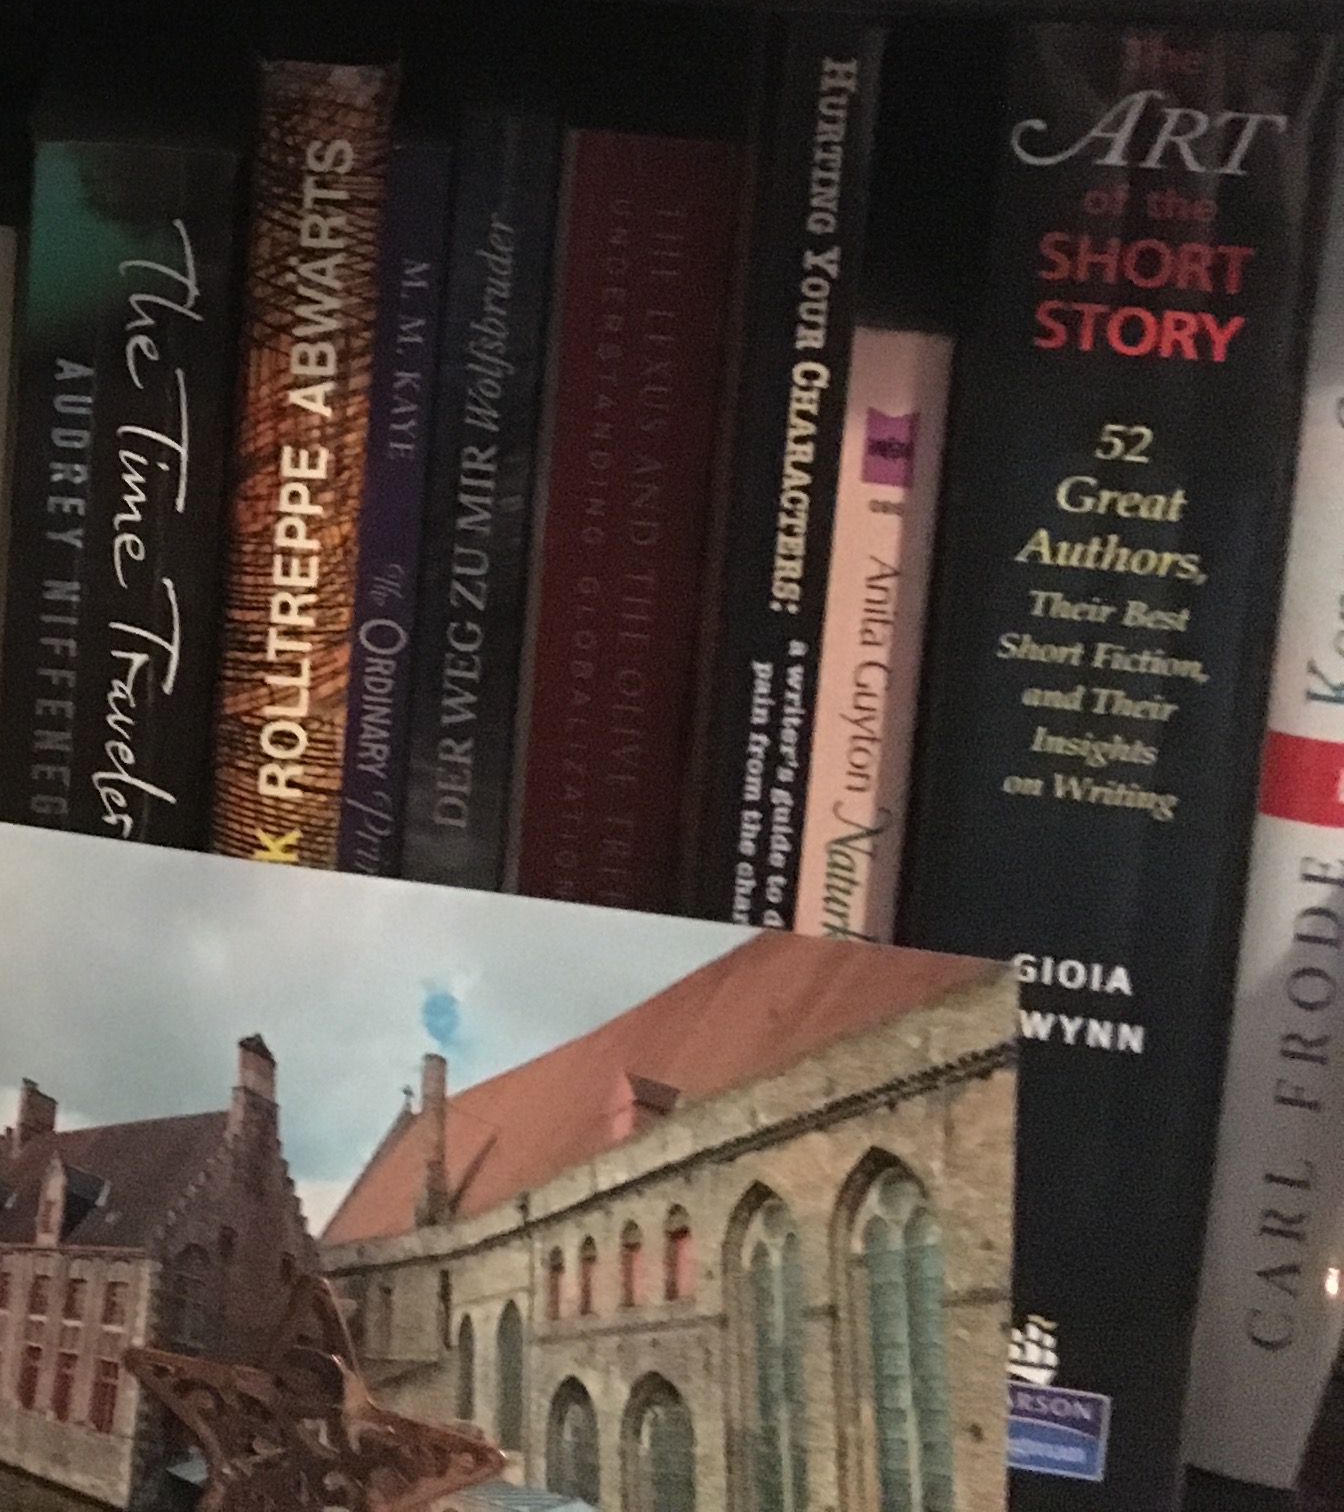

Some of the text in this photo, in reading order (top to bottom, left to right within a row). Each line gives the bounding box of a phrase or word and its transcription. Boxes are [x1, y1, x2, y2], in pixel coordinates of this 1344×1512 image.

[1009, 89, 1288, 176] ART
[1083, 187, 1218, 222] of the
[1036, 231, 1257, 295] SHORT
[117, 218, 203, 388] The
[1032, 299, 1246, 363] STORY
[387, 257, 431, 461] M. M. KAYE
[256, 135, 353, 799] ROLLTREPPE ABWÄRTS
[1093, 422, 1154, 464] 52
[111, 368, 188, 588] Time
[1055, 475, 1188, 523] Great
[433, 211, 516, 828] DER WEG ZU MIR Wolfsbruder
[28, 356, 95, 816] AUDREY NIFFENEG
[1013, 526, 1209, 586] Authors,
[858, 555, 902, 647] Anita
[1028, 588, 1191, 633] Their Best
[996, 631, 1211, 686] Short Fiction,
[750, 660, 775, 725] pain
[1019, 684, 1181, 723] and Their
[838, 660, 893, 794] Guyton
[1028, 724, 1160, 768] Insights
[742, 732, 771, 801] from
[763, 638, 809, 904] a writer's guide to
[1002, 772, 1180, 823] on Writing
[737, 809, 764, 857] the
[1012, 951, 1133, 997] GIOIA
[1018, 1009, 1145, 1055] WYNN
[1246, 1160, 1314, 1352] CARL
